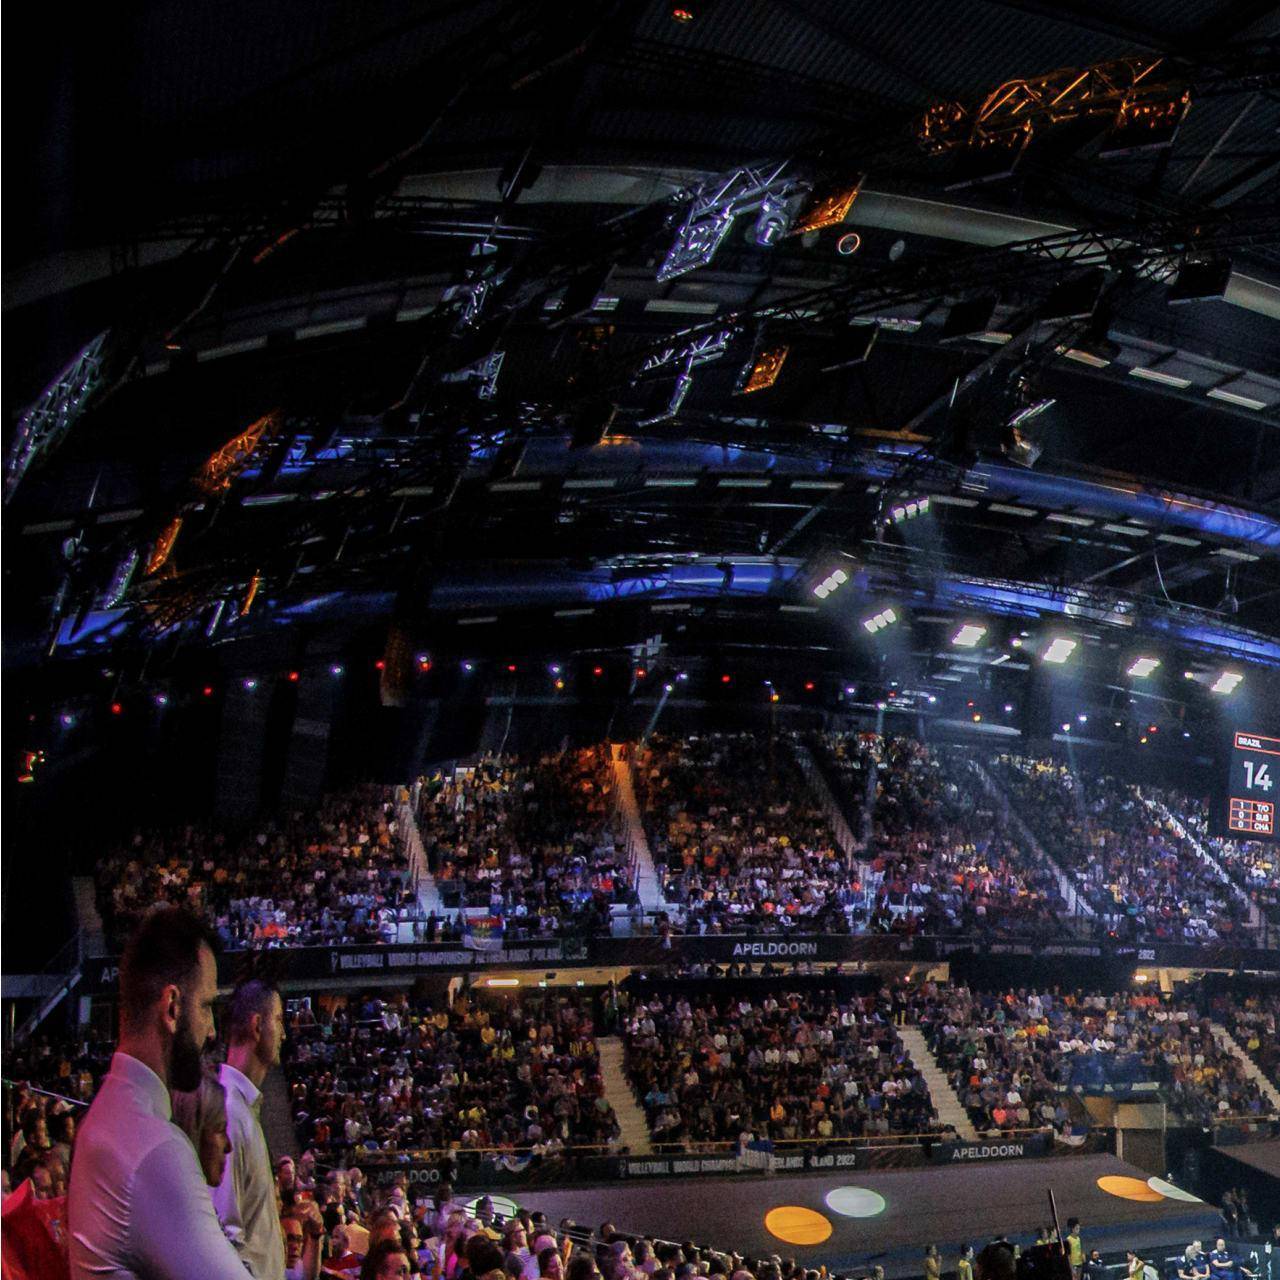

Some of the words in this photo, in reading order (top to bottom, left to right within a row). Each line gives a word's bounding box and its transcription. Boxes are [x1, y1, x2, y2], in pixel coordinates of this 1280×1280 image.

[1238, 737, 1261, 748] BRAZIL
[1243, 761, 1273, 791] 14
[1240, 801, 1244, 809] 1
[733, 942, 817, 955] APELDOORN
[952, 1144, 1024, 1160] APELDOORN
